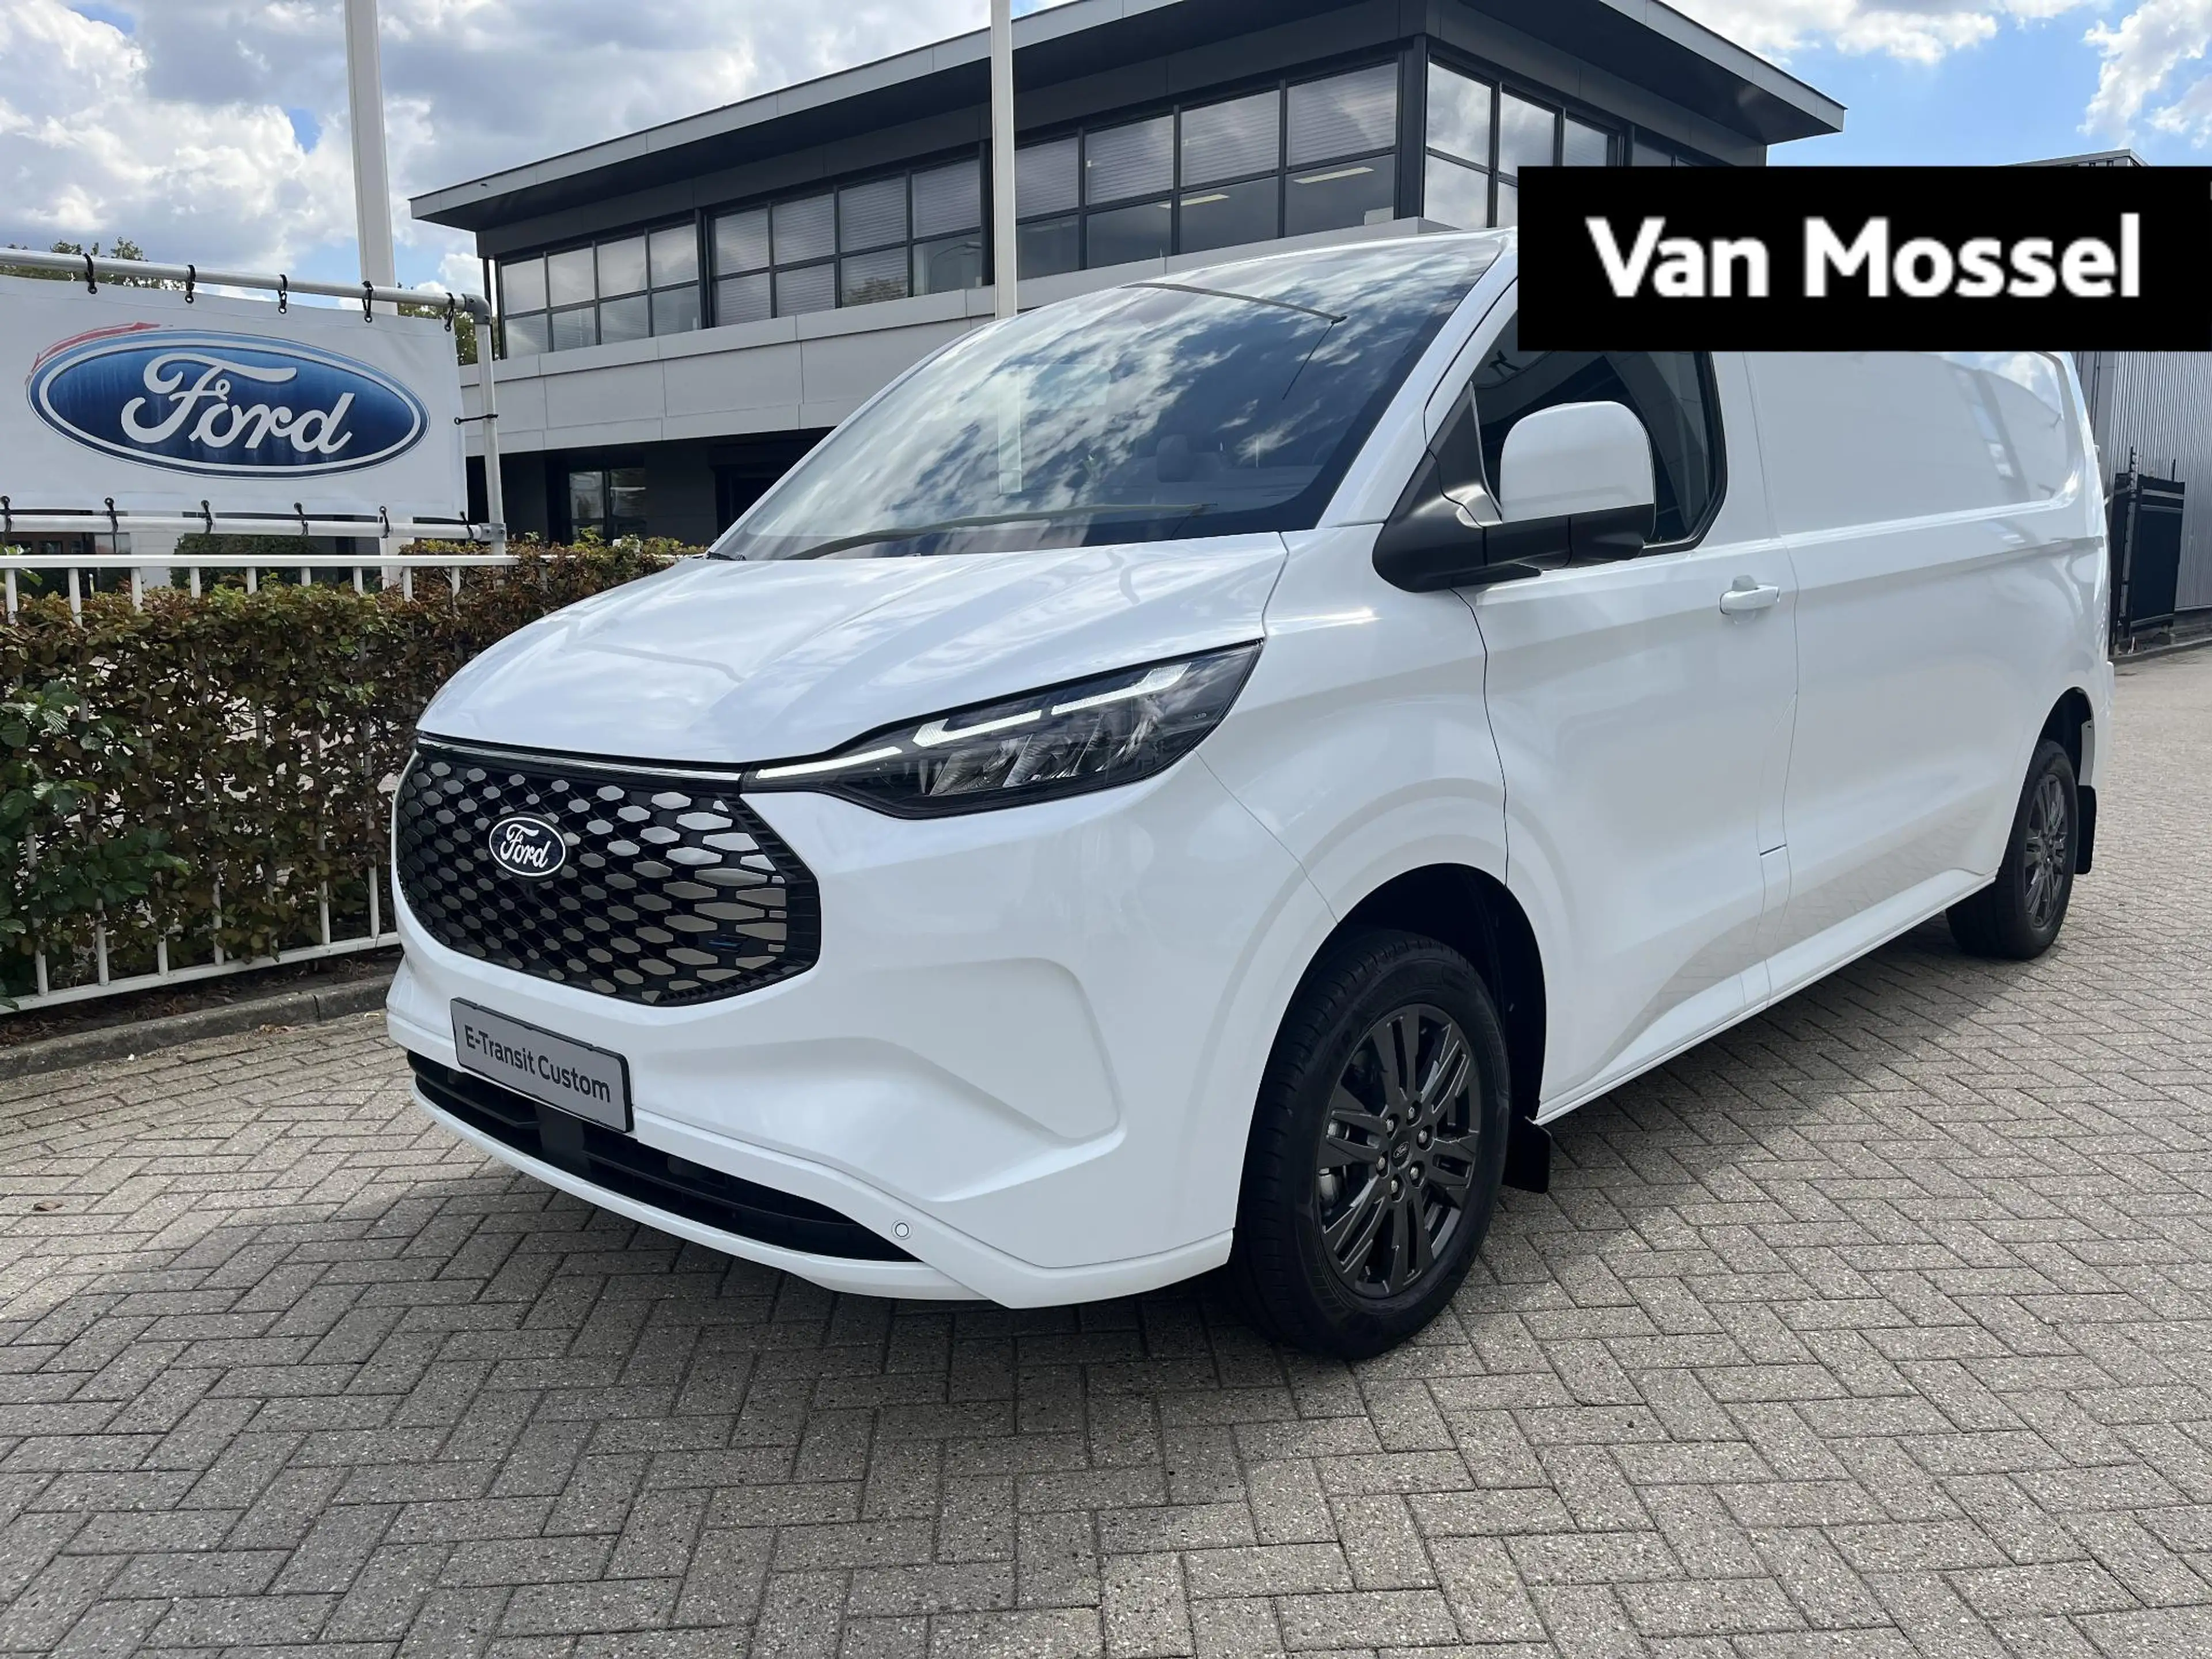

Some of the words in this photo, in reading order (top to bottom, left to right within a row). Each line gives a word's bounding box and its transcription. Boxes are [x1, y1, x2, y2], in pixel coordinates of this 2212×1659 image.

[122, 353, 355, 454] Ford
[500, 823, 551, 868] Ford
[464, 1024, 536, 1075] E-Transit
[537, 1055, 611, 1103] Custom
